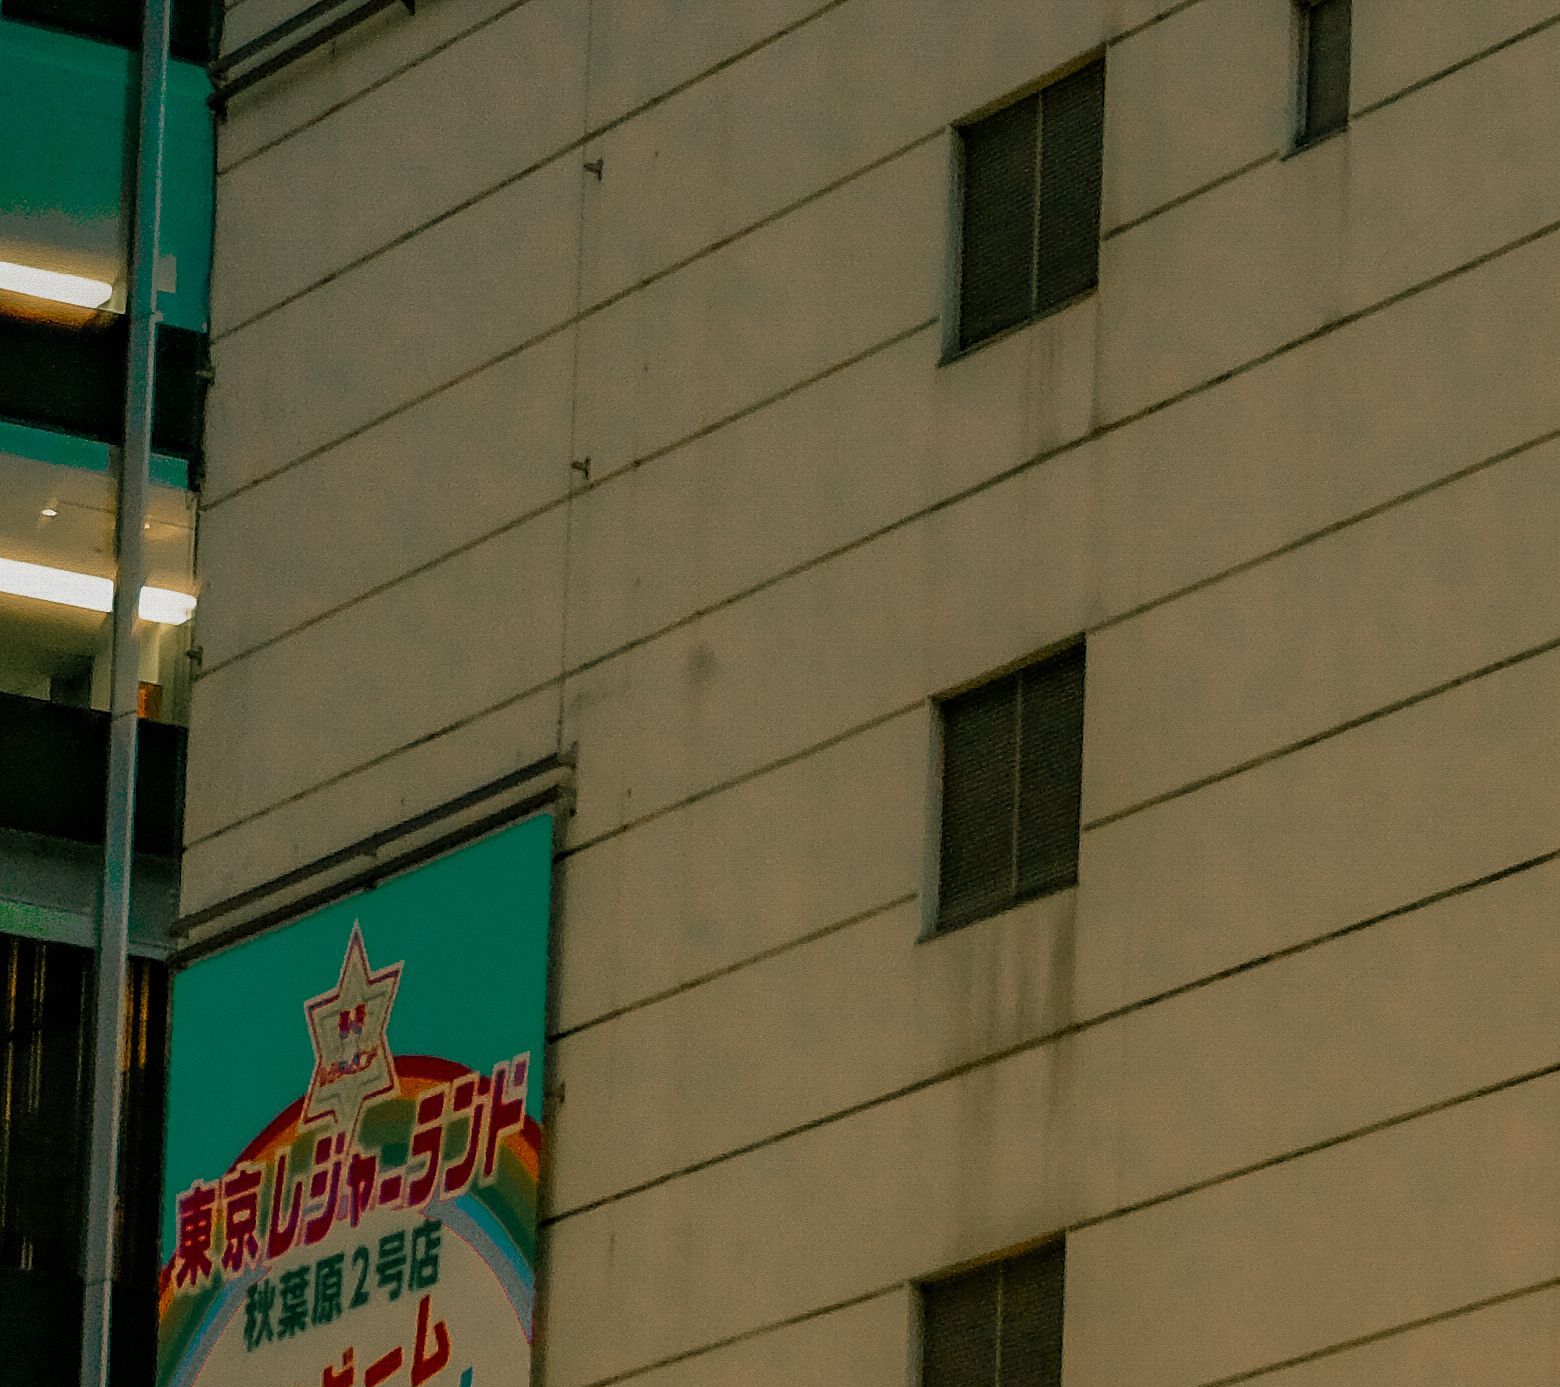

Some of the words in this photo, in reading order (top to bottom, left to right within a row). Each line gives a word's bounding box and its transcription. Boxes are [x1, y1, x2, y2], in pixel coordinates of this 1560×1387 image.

[177, 1053, 529, 1290] 東京レジャーランド
[244, 1220, 441, 1351] 秋葉原2号店
